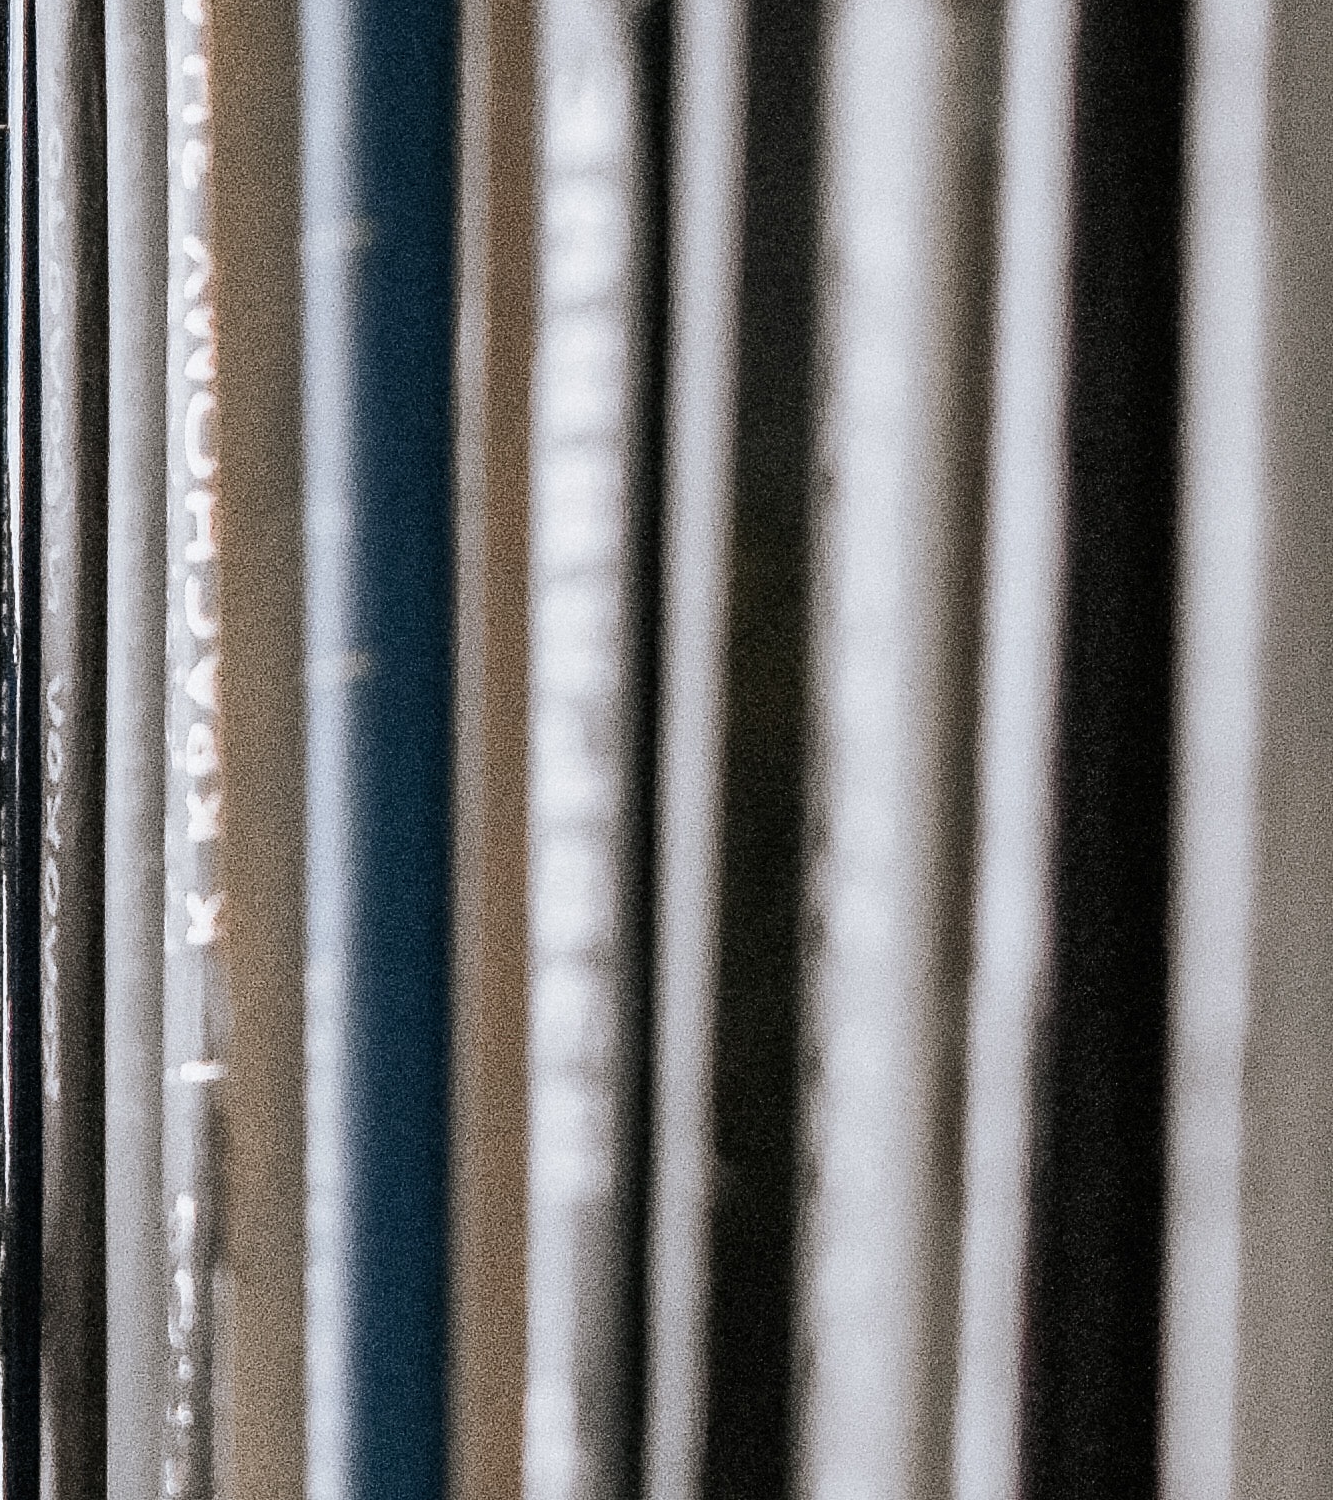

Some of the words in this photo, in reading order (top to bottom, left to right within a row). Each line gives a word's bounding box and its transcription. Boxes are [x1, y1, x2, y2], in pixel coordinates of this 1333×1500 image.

[44, 121, 66, 508] БОЛОТО
[181, 234, 222, 844] КРАСНОМУ
[43, 670, 66, 1102] КОЛОКОЛ
